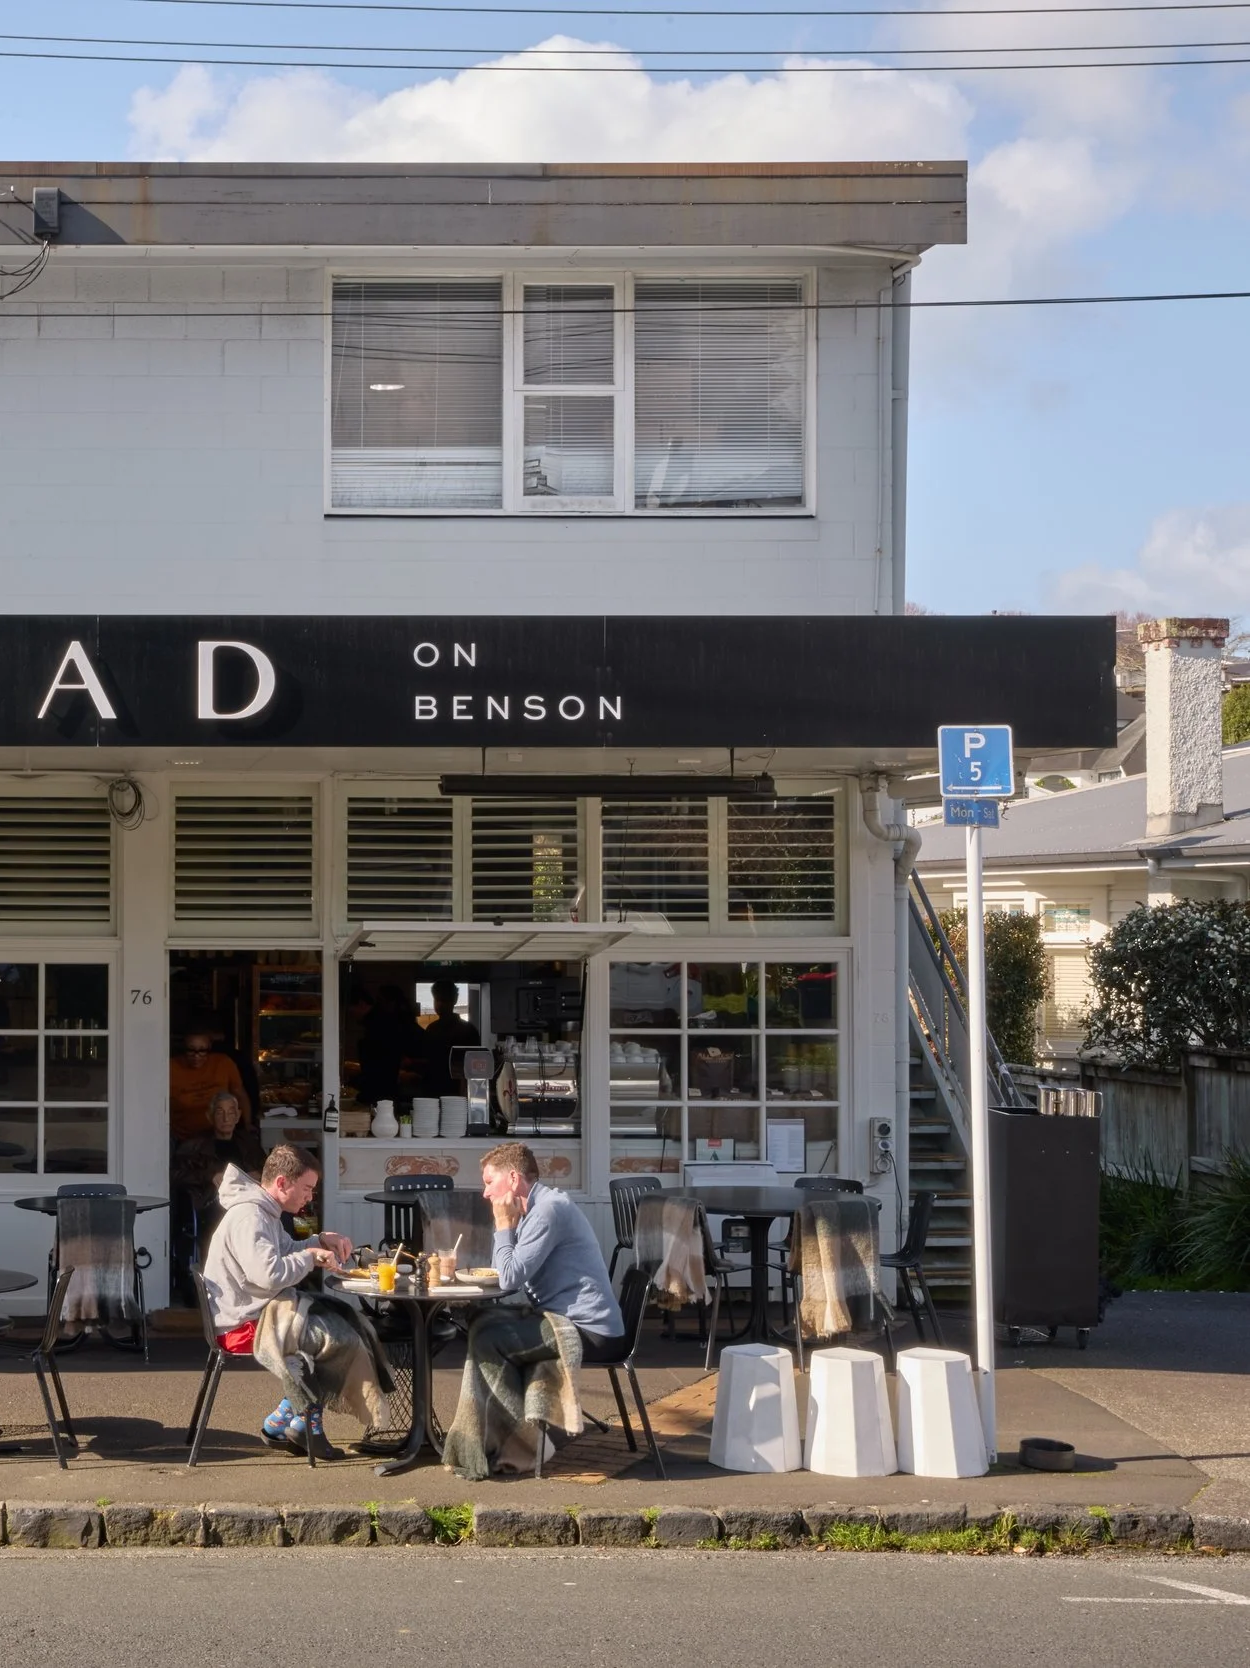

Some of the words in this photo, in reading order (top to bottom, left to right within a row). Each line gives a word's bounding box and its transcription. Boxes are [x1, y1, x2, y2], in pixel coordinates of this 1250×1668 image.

[413, 642, 476, 667] ON
[414, 695, 622, 720] BENSON
[964, 733, 986, 758] P
[970, 762, 981, 781] 5
[950, 807, 974, 818] Mon
[131, 989, 152, 1005] 76
